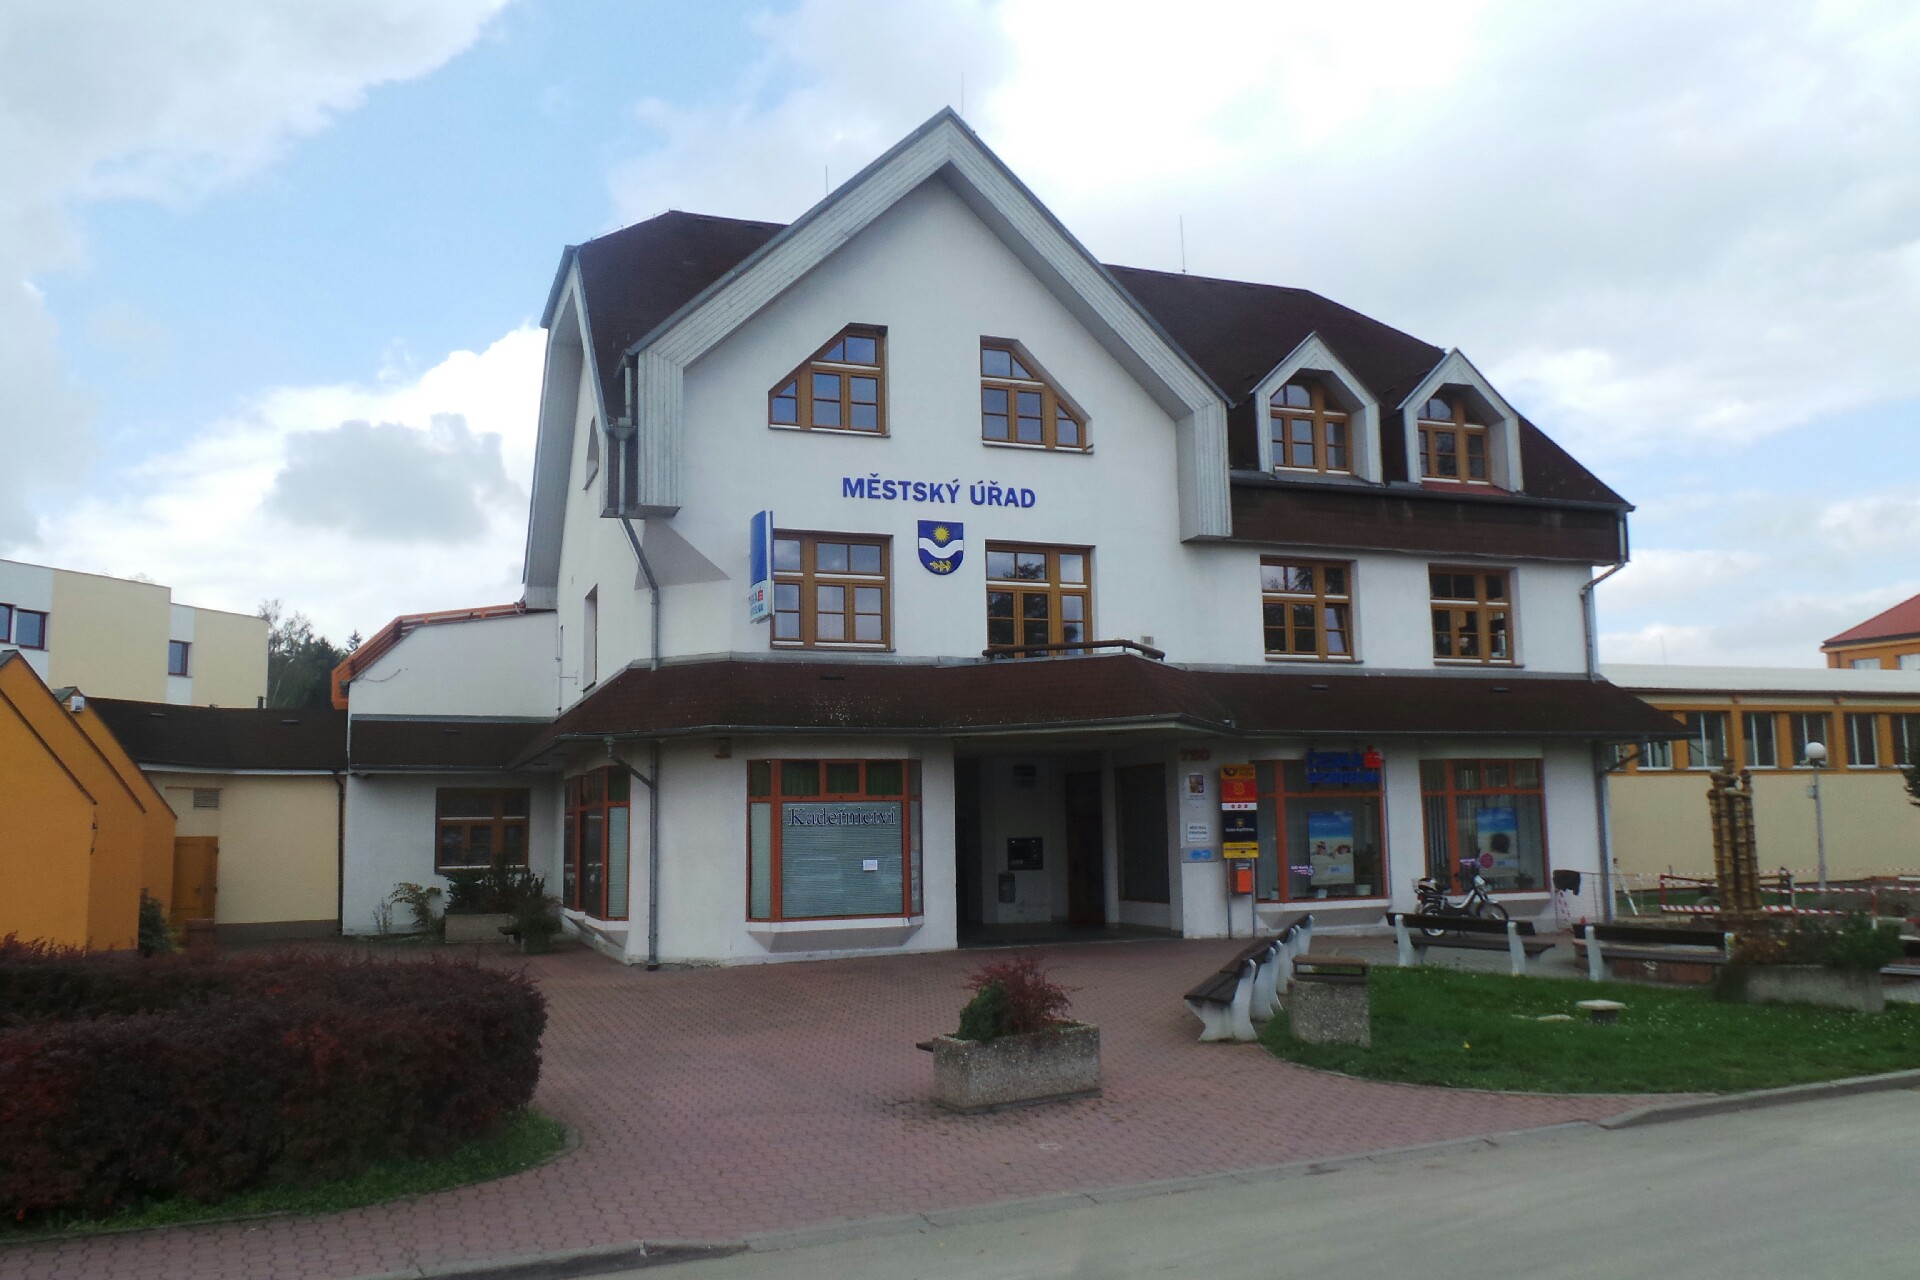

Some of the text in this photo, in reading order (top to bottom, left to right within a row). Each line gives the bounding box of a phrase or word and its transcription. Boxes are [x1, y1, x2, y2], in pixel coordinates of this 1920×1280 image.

[842, 473, 1036, 508] MĚSTSKÝ ÚŘAD
[788, 806, 896, 826] Kadeřnictví
